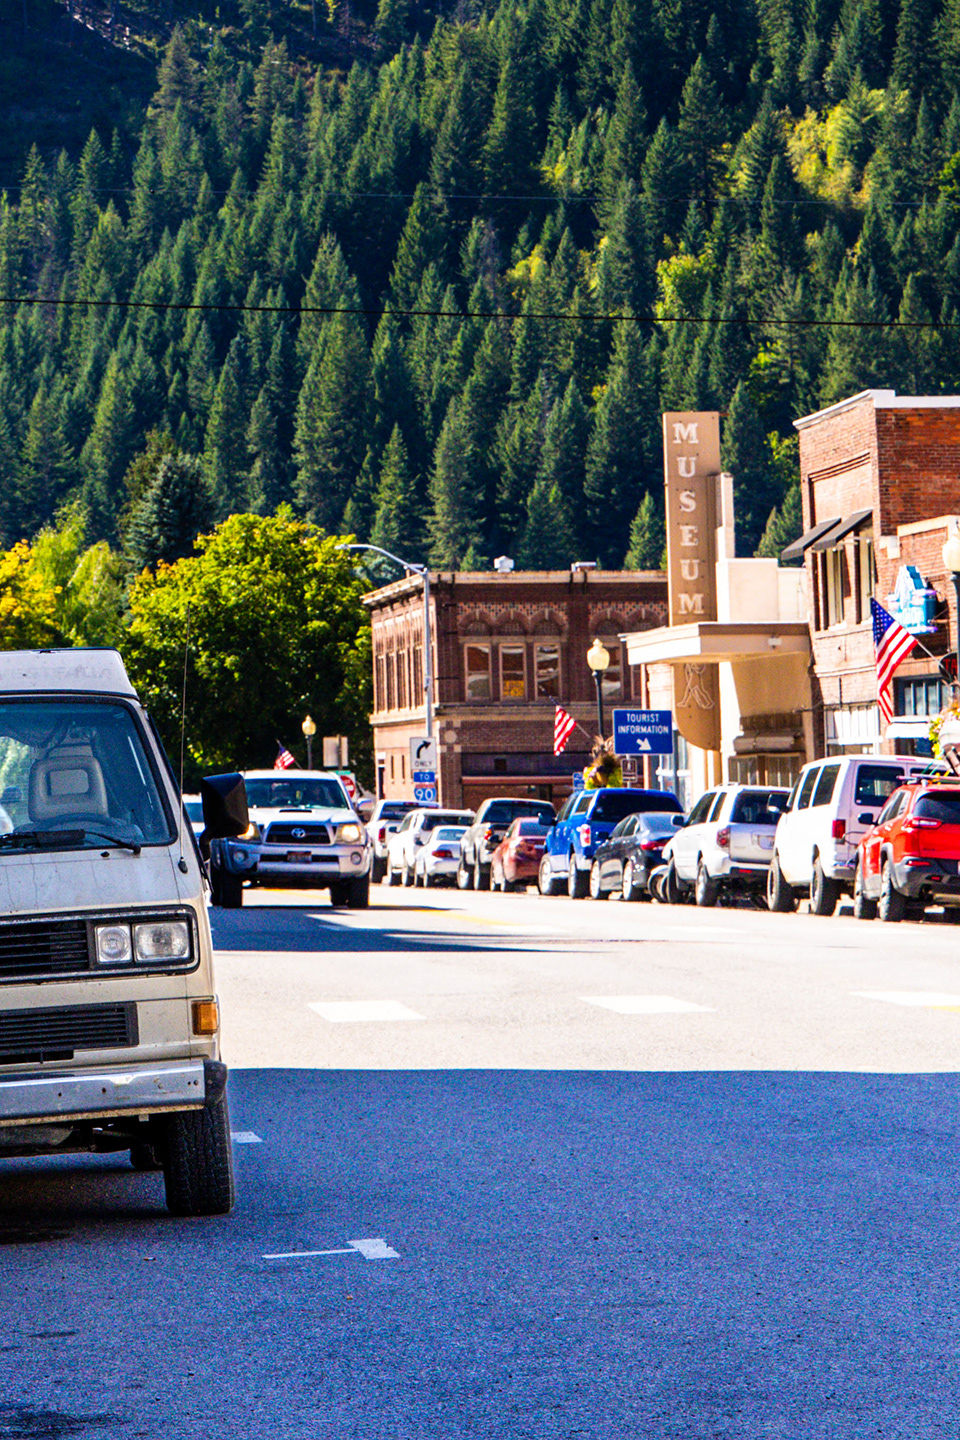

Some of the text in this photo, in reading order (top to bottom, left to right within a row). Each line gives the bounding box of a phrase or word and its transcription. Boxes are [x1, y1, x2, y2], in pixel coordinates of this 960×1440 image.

[672, 422, 705, 615] MUSEUM
[627, 713, 659, 723] TOURIST
[618, 725, 669, 735] INFORMATION
[415, 789, 434, 800] 90
